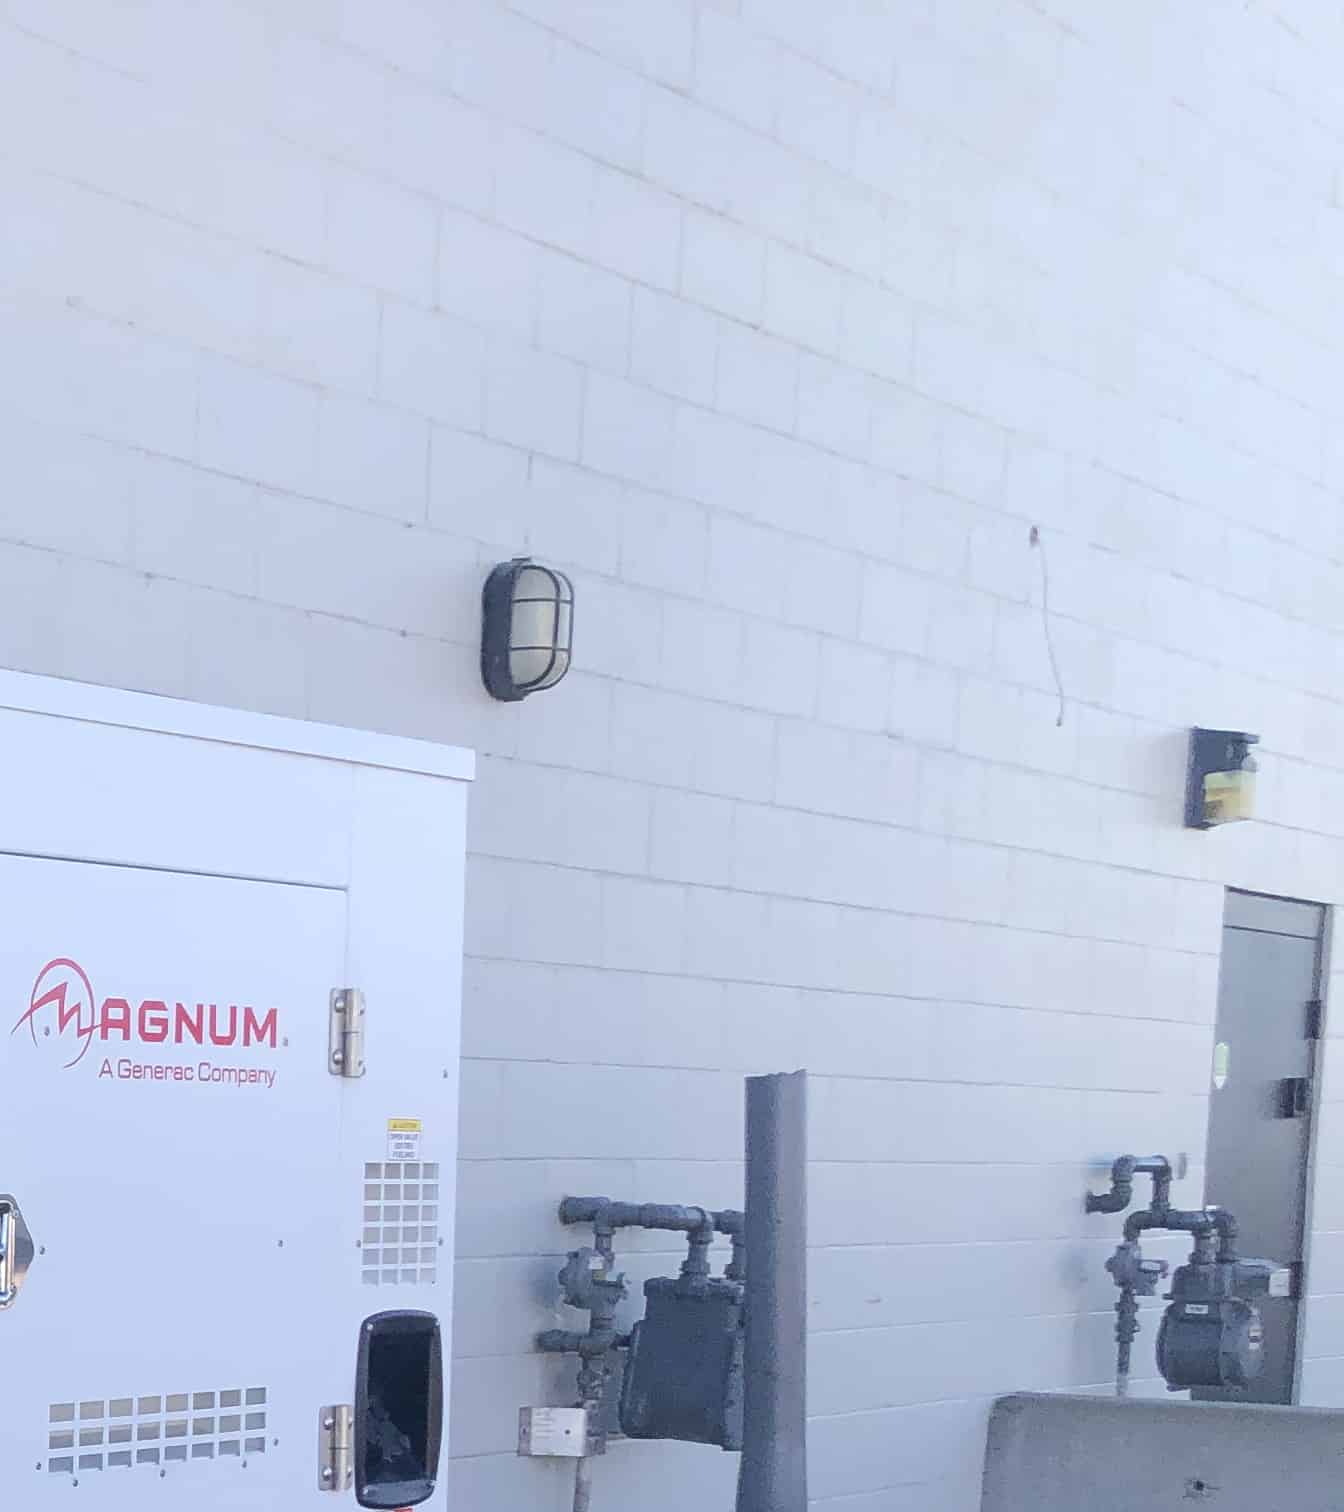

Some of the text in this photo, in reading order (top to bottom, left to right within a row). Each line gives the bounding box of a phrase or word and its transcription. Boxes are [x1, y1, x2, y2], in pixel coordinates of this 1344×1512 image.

[11, 978, 278, 1050] MAGNUM
[98, 1058, 277, 1089] A Generac Company
